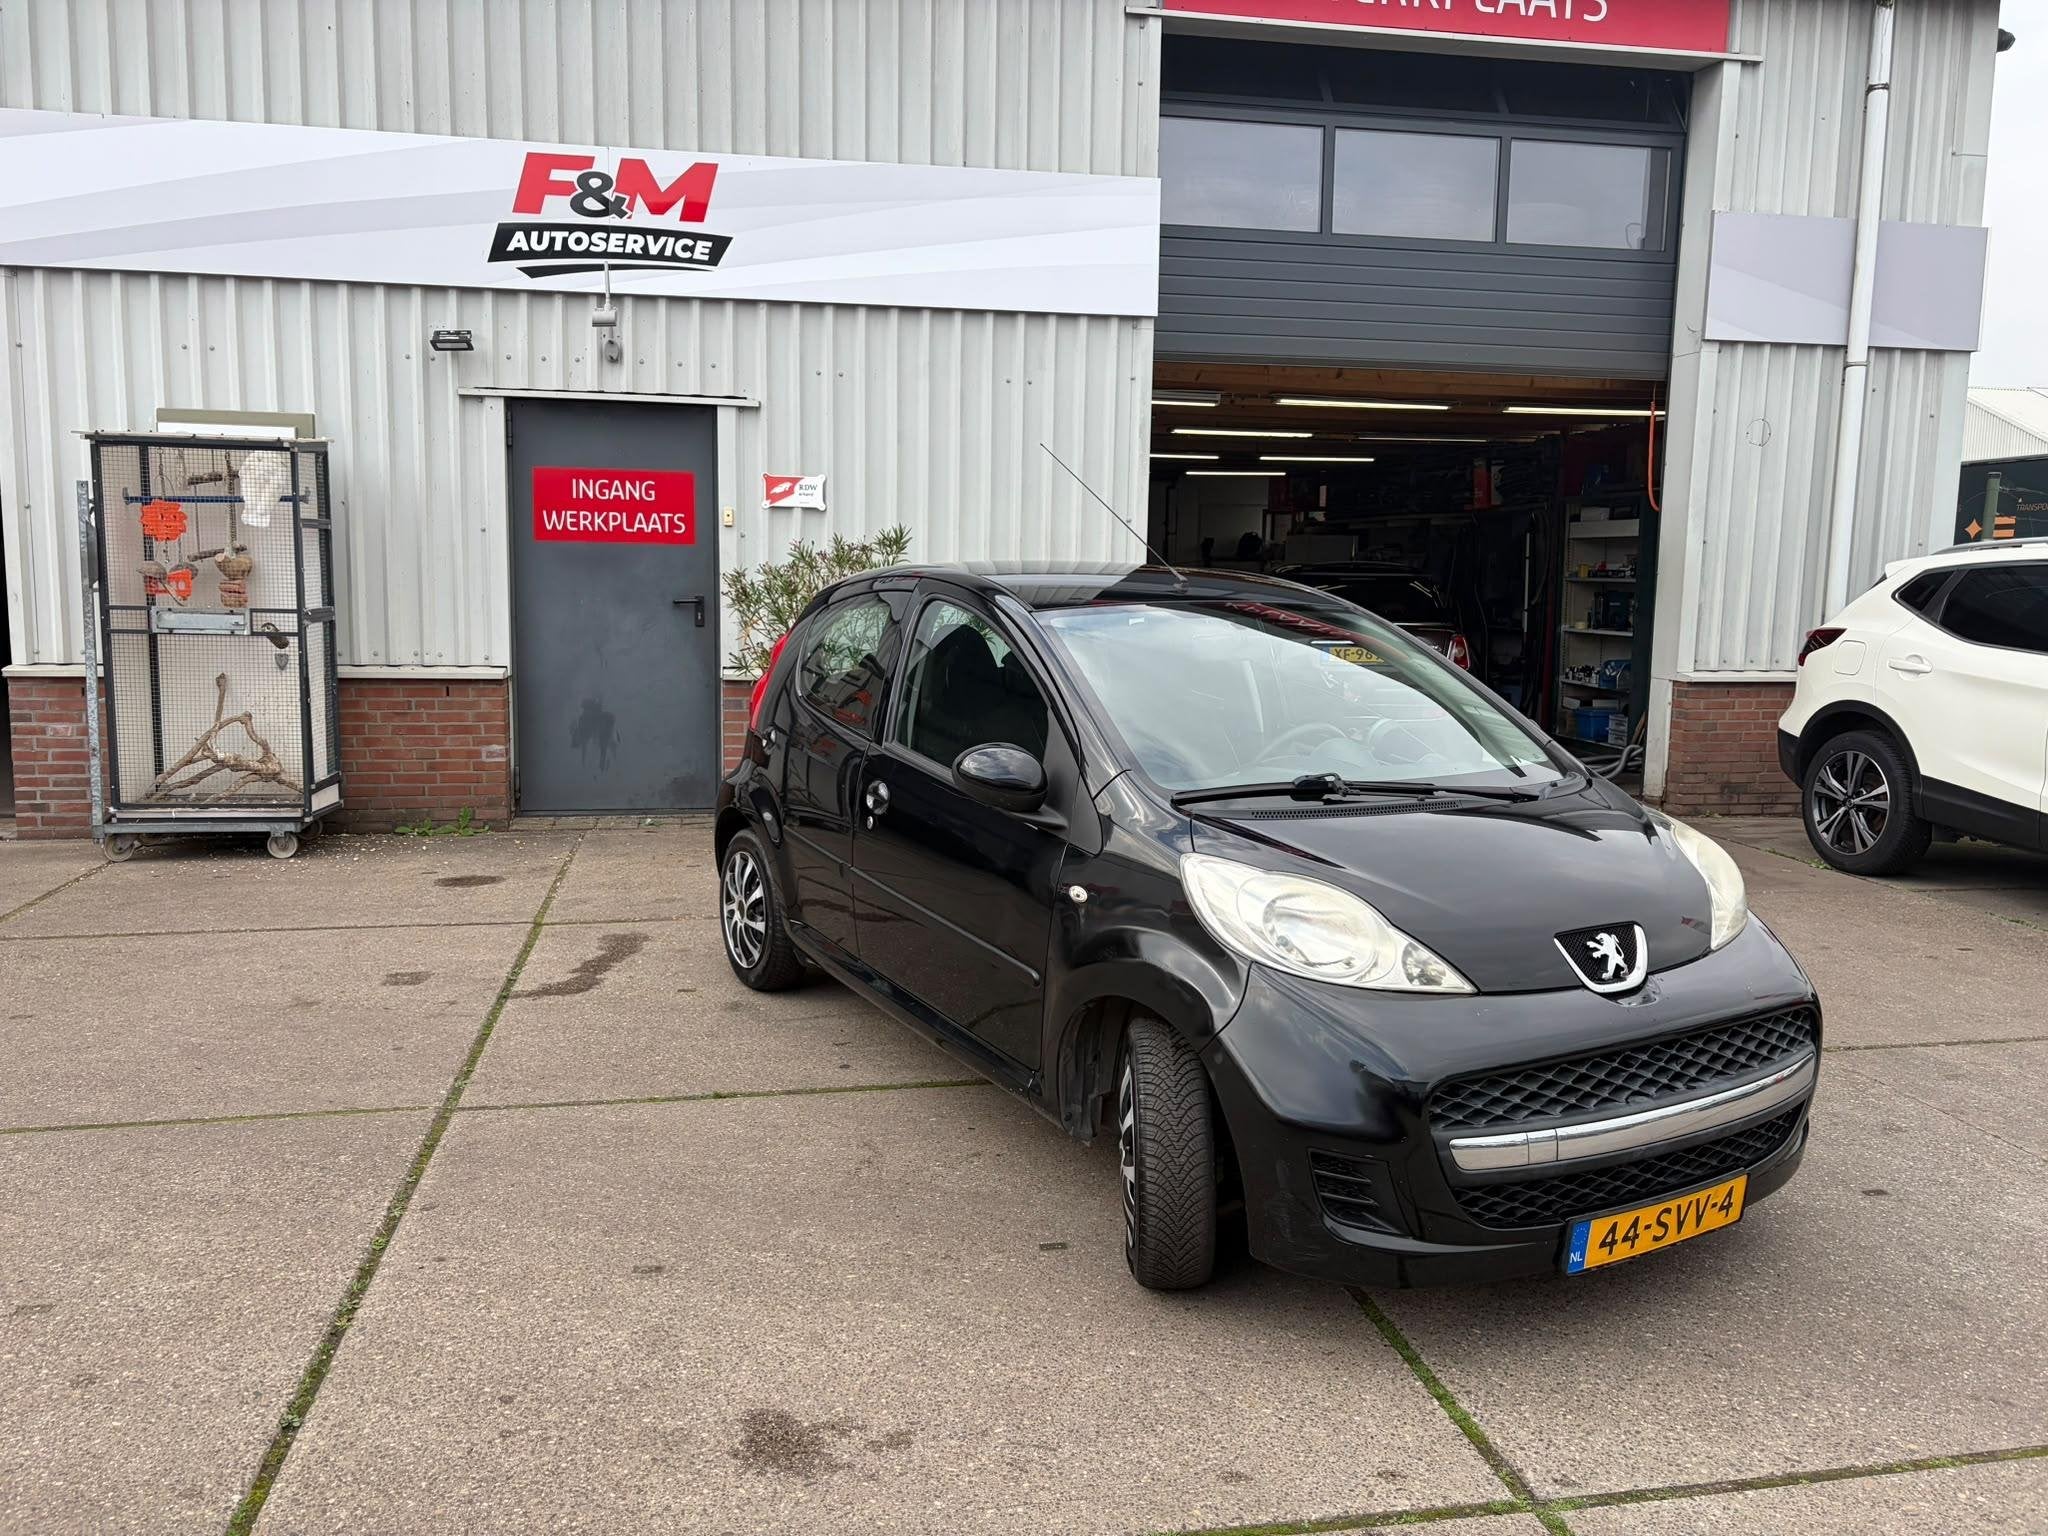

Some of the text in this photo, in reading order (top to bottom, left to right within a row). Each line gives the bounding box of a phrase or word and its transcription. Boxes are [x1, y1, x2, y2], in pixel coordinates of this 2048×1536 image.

[512, 152, 719, 223] F&M
[508, 230, 713, 261] AUTOSERVICE
[571, 478, 656, 501] INGANG
[543, 509, 686, 534] WERKPLAATS
[1334, 648, 1382, 661] XF-96
[1598, 1185, 1735, 1255] 44-SVV-4
[1569, 1251, 1583, 1263] NL
